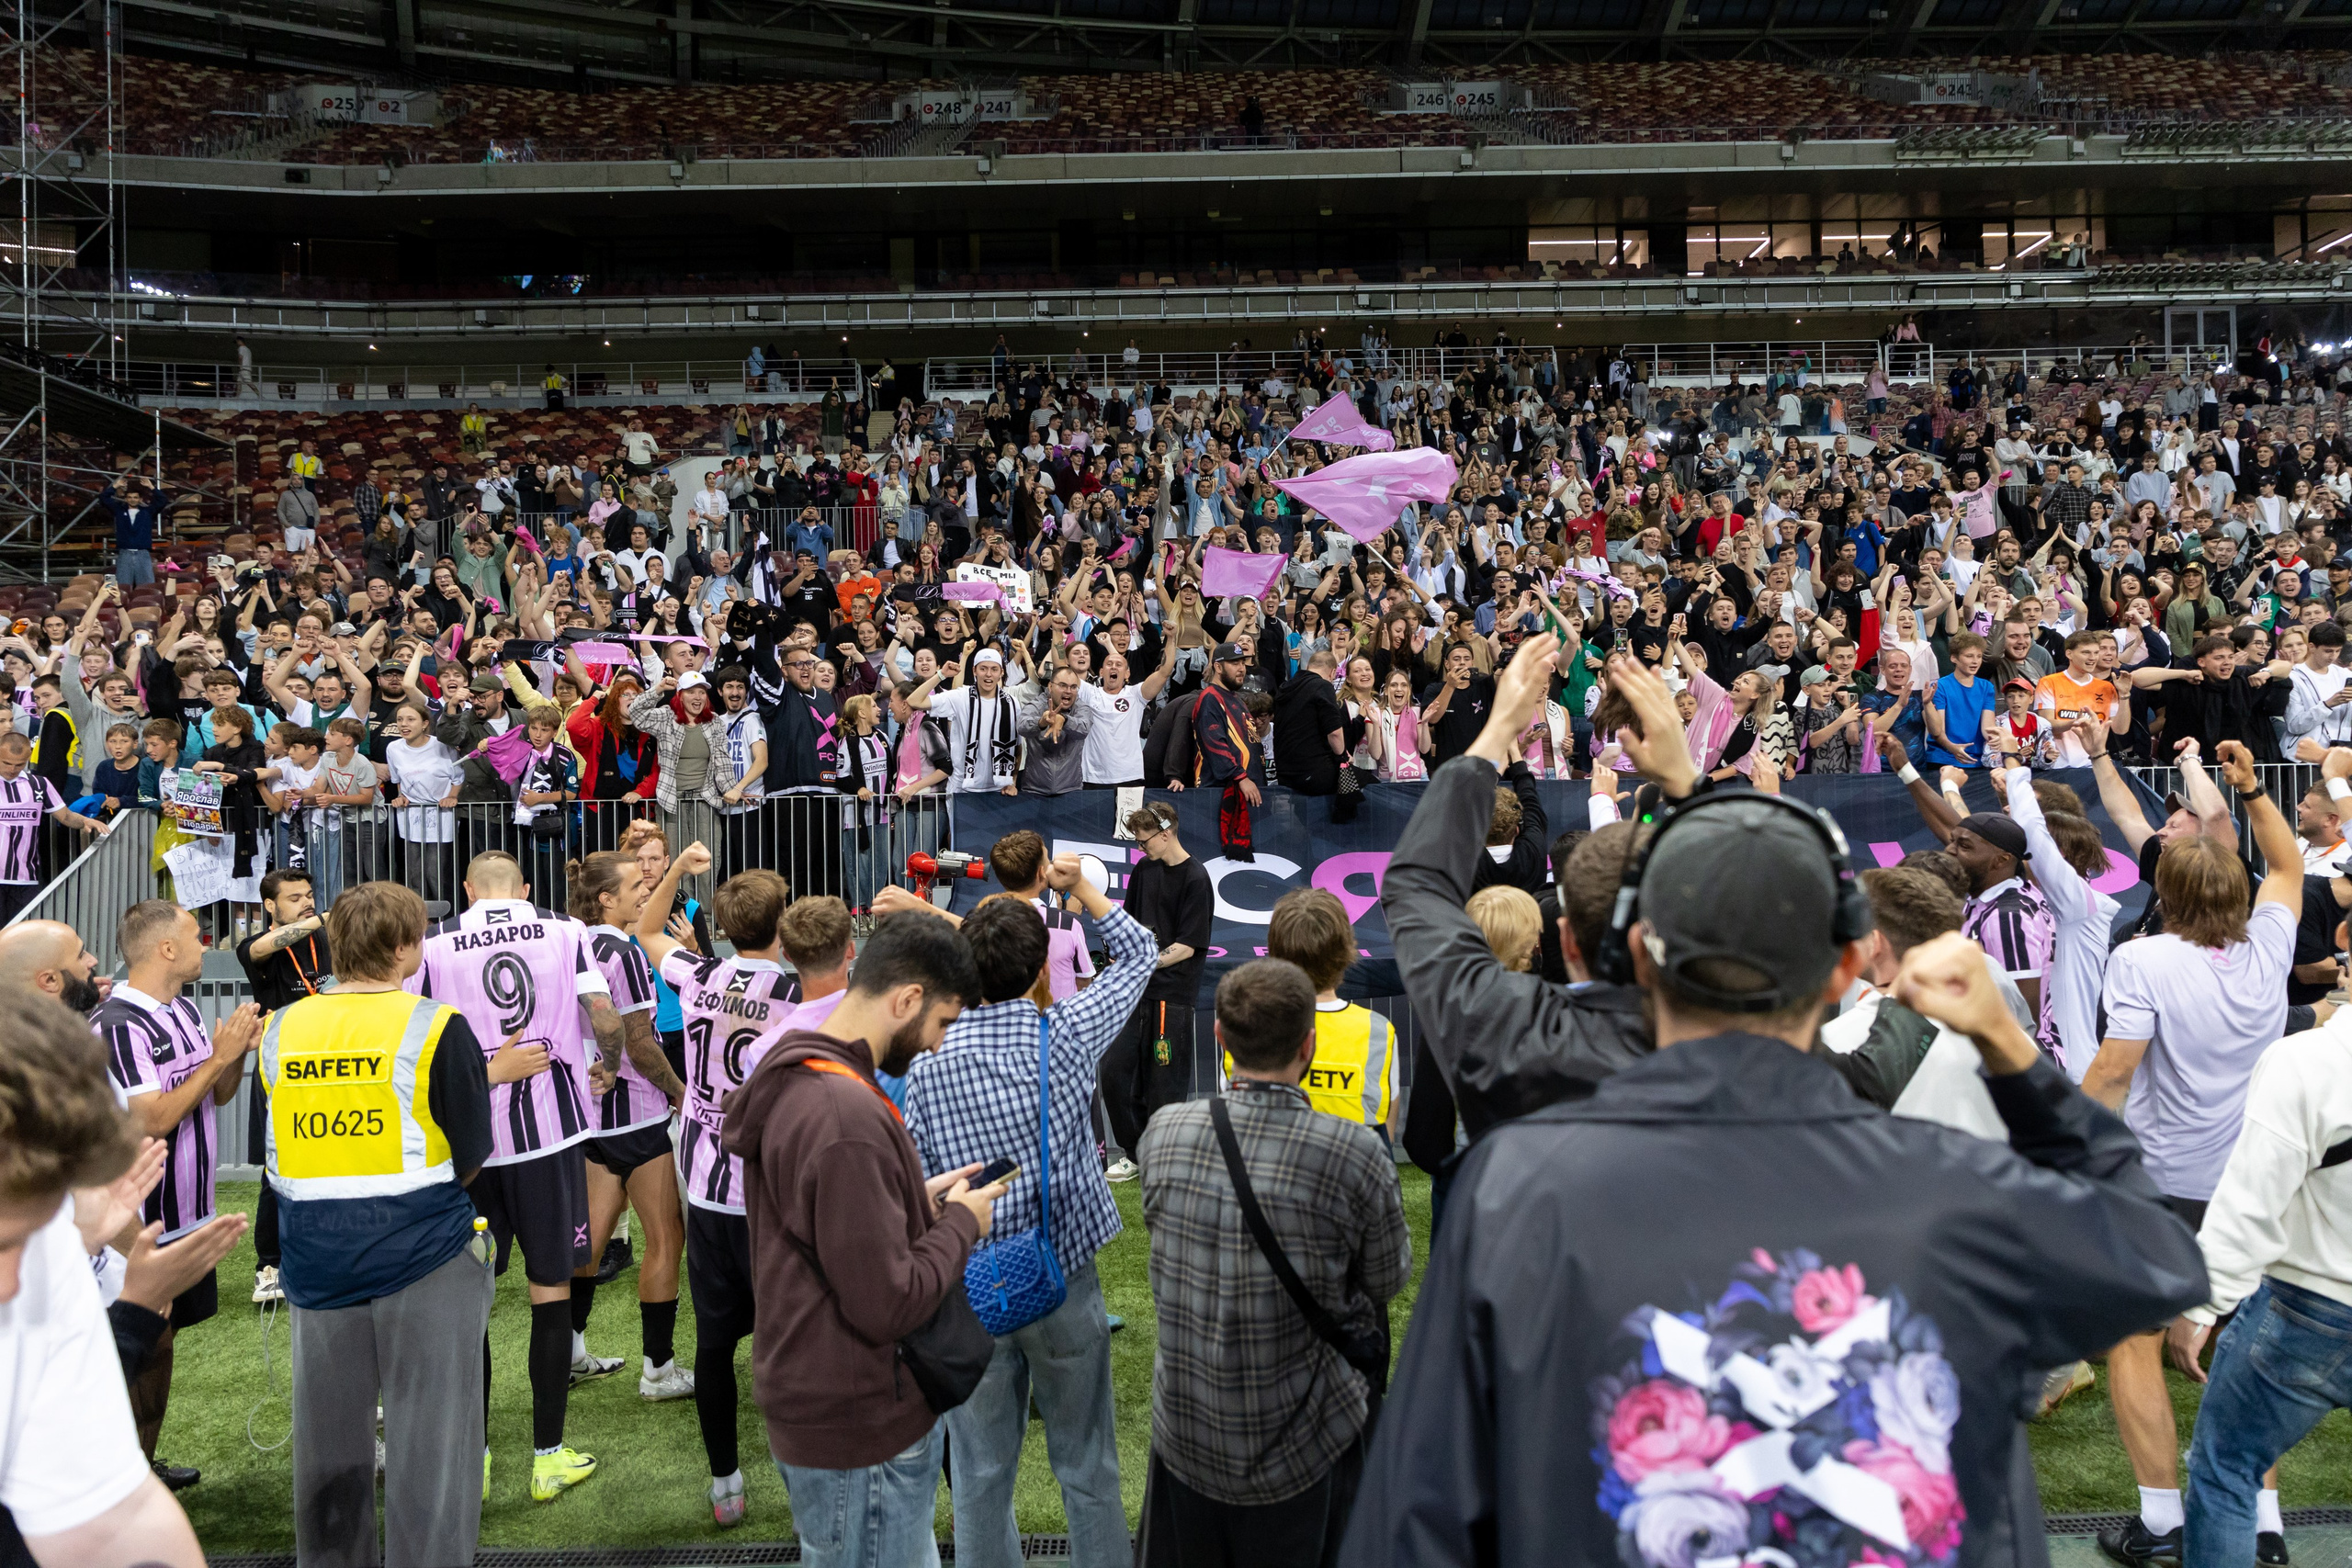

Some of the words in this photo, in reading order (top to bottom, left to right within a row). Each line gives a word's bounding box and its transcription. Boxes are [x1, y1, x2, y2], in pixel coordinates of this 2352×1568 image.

[1417, 94, 1443, 106] 246
[1468, 93, 1495, 106] 245
[934, 102, 962, 114] 248
[986, 101, 1011, 114] 247
[973, 567, 992, 578] ВСЕ
[819, 752, 835, 762] FC
[864, 763, 886, 773] Winline
[176, 791, 220, 805] Ярослав
[183, 819, 218, 832] Подари
[453, 924, 545, 952] НАЗАРОВ
[482, 951, 536, 1036] 9
[694, 990, 771, 1021] ЕФИМОВ
[286, 1057, 382, 1080] SAFETY
[1309, 1069, 1355, 1089] ETY
